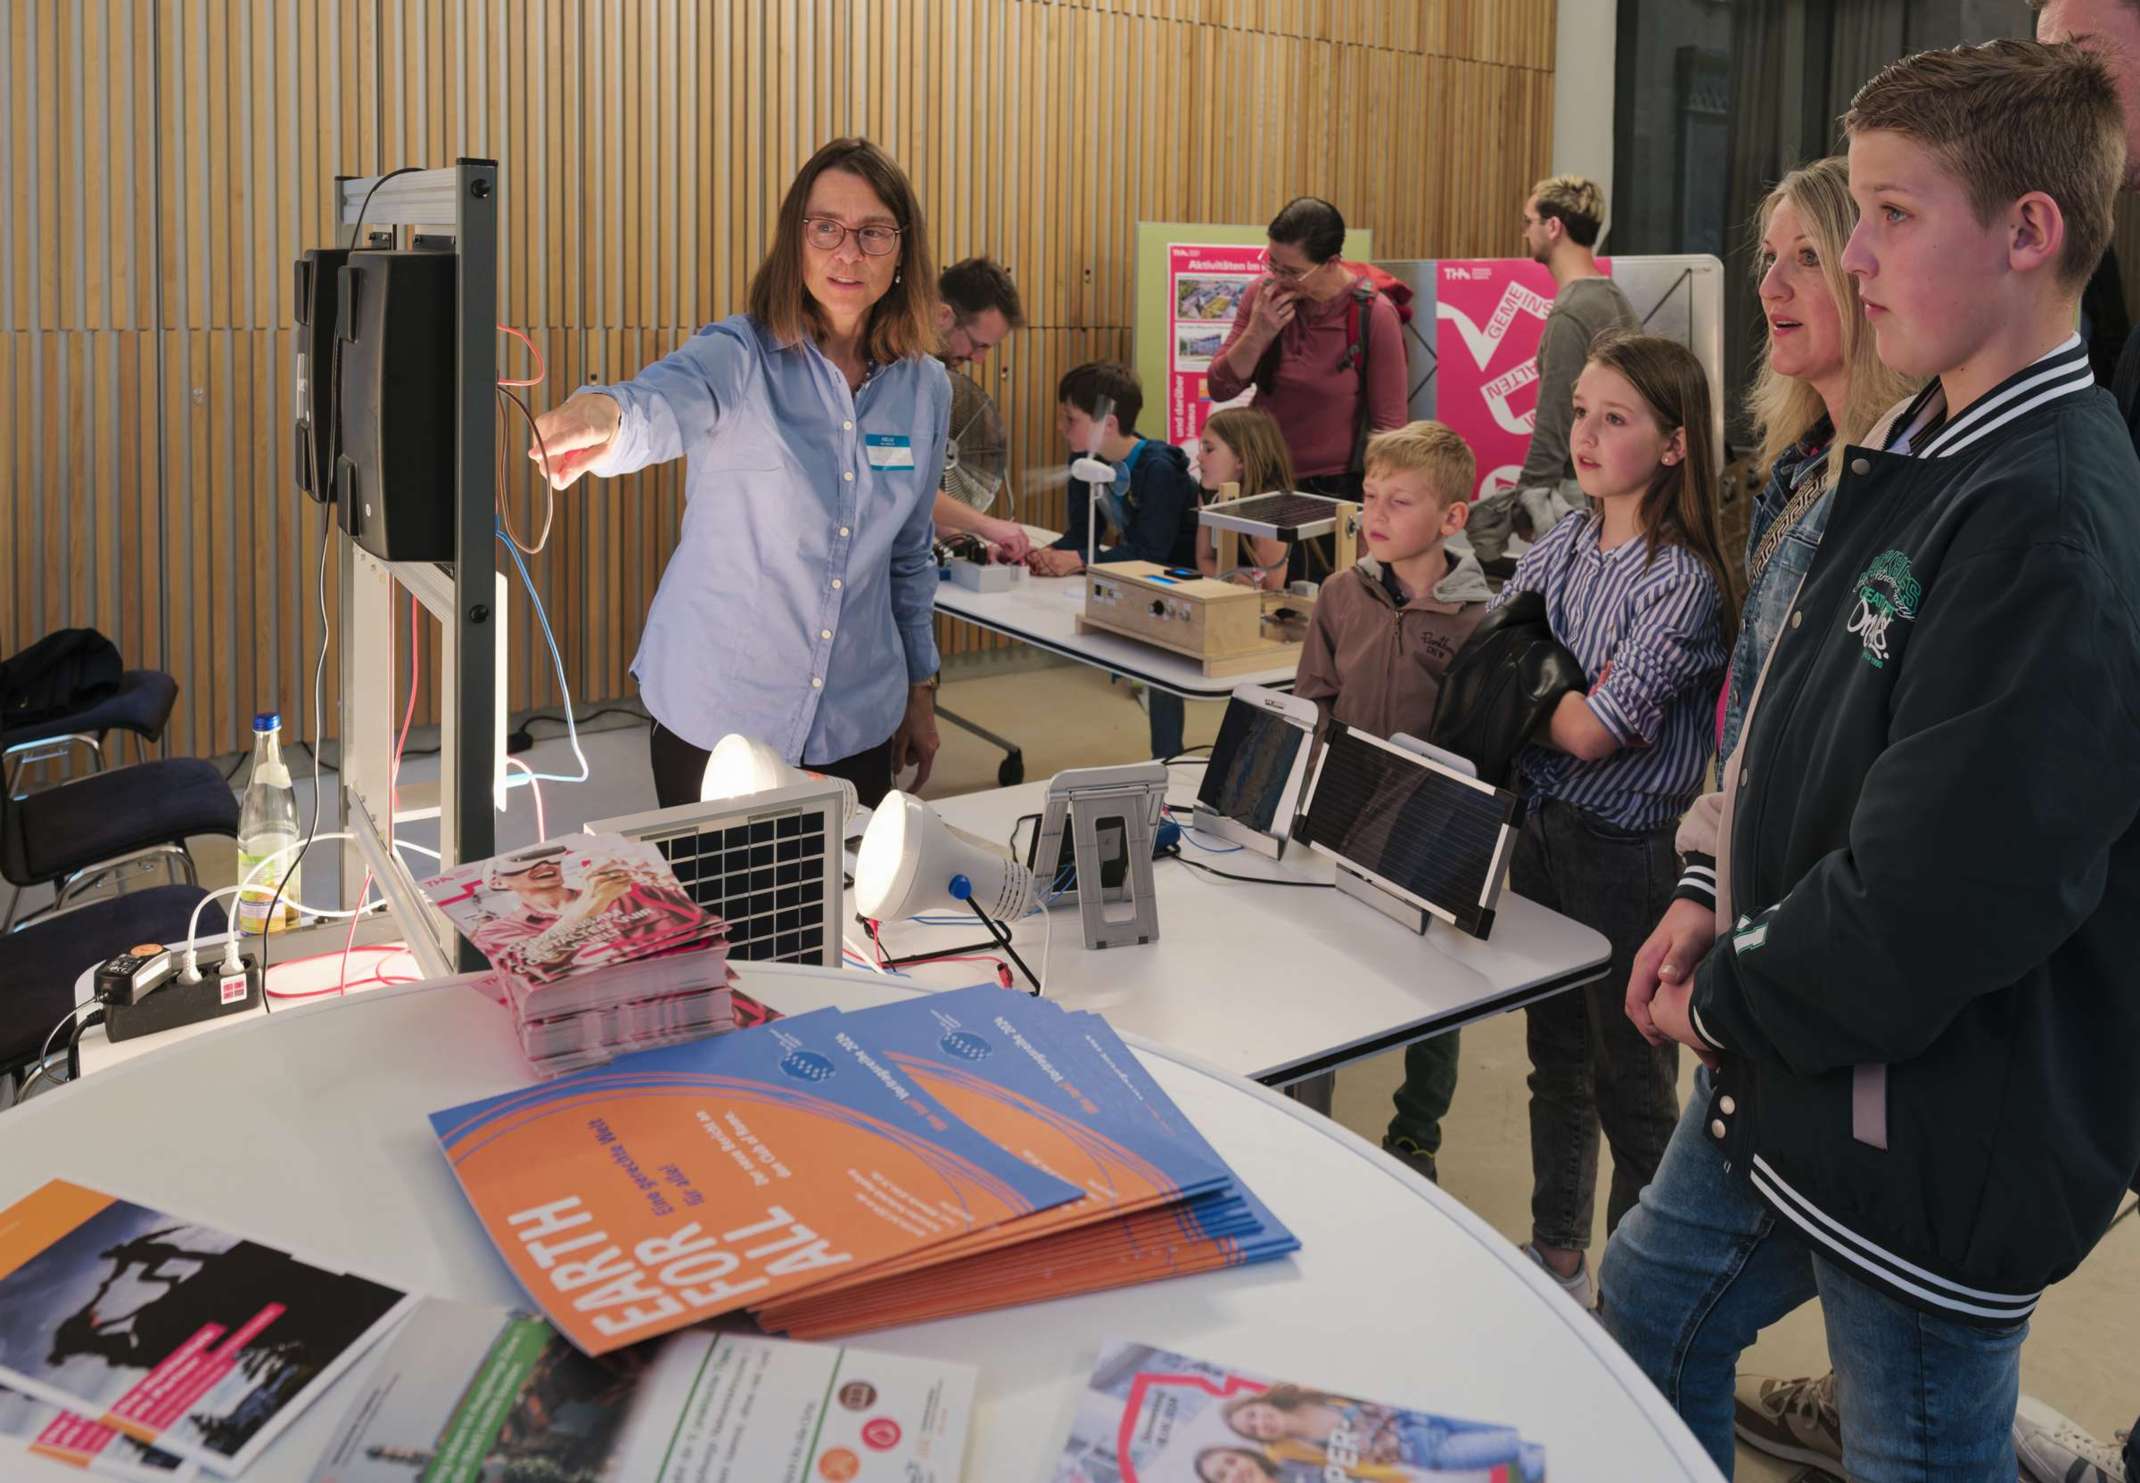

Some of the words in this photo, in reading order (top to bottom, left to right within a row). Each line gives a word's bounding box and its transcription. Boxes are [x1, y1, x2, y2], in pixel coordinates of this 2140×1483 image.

[1188, 261, 1245, 271] Aktivitäten
[1444, 267, 1471, 280] THA
[1174, 374, 1185, 416] darüber
[1175, 417, 1185, 438] und
[589, 1119, 615, 1144] Welt
[611, 1145, 655, 1189] gerechte
[648, 1192, 673, 1216] Eine
[684, 1190, 704, 1205] für
[723, 1206, 853, 1275] ALL
[508, 1196, 685, 1336] EARTH
[635, 1222, 769, 1307] FOR
